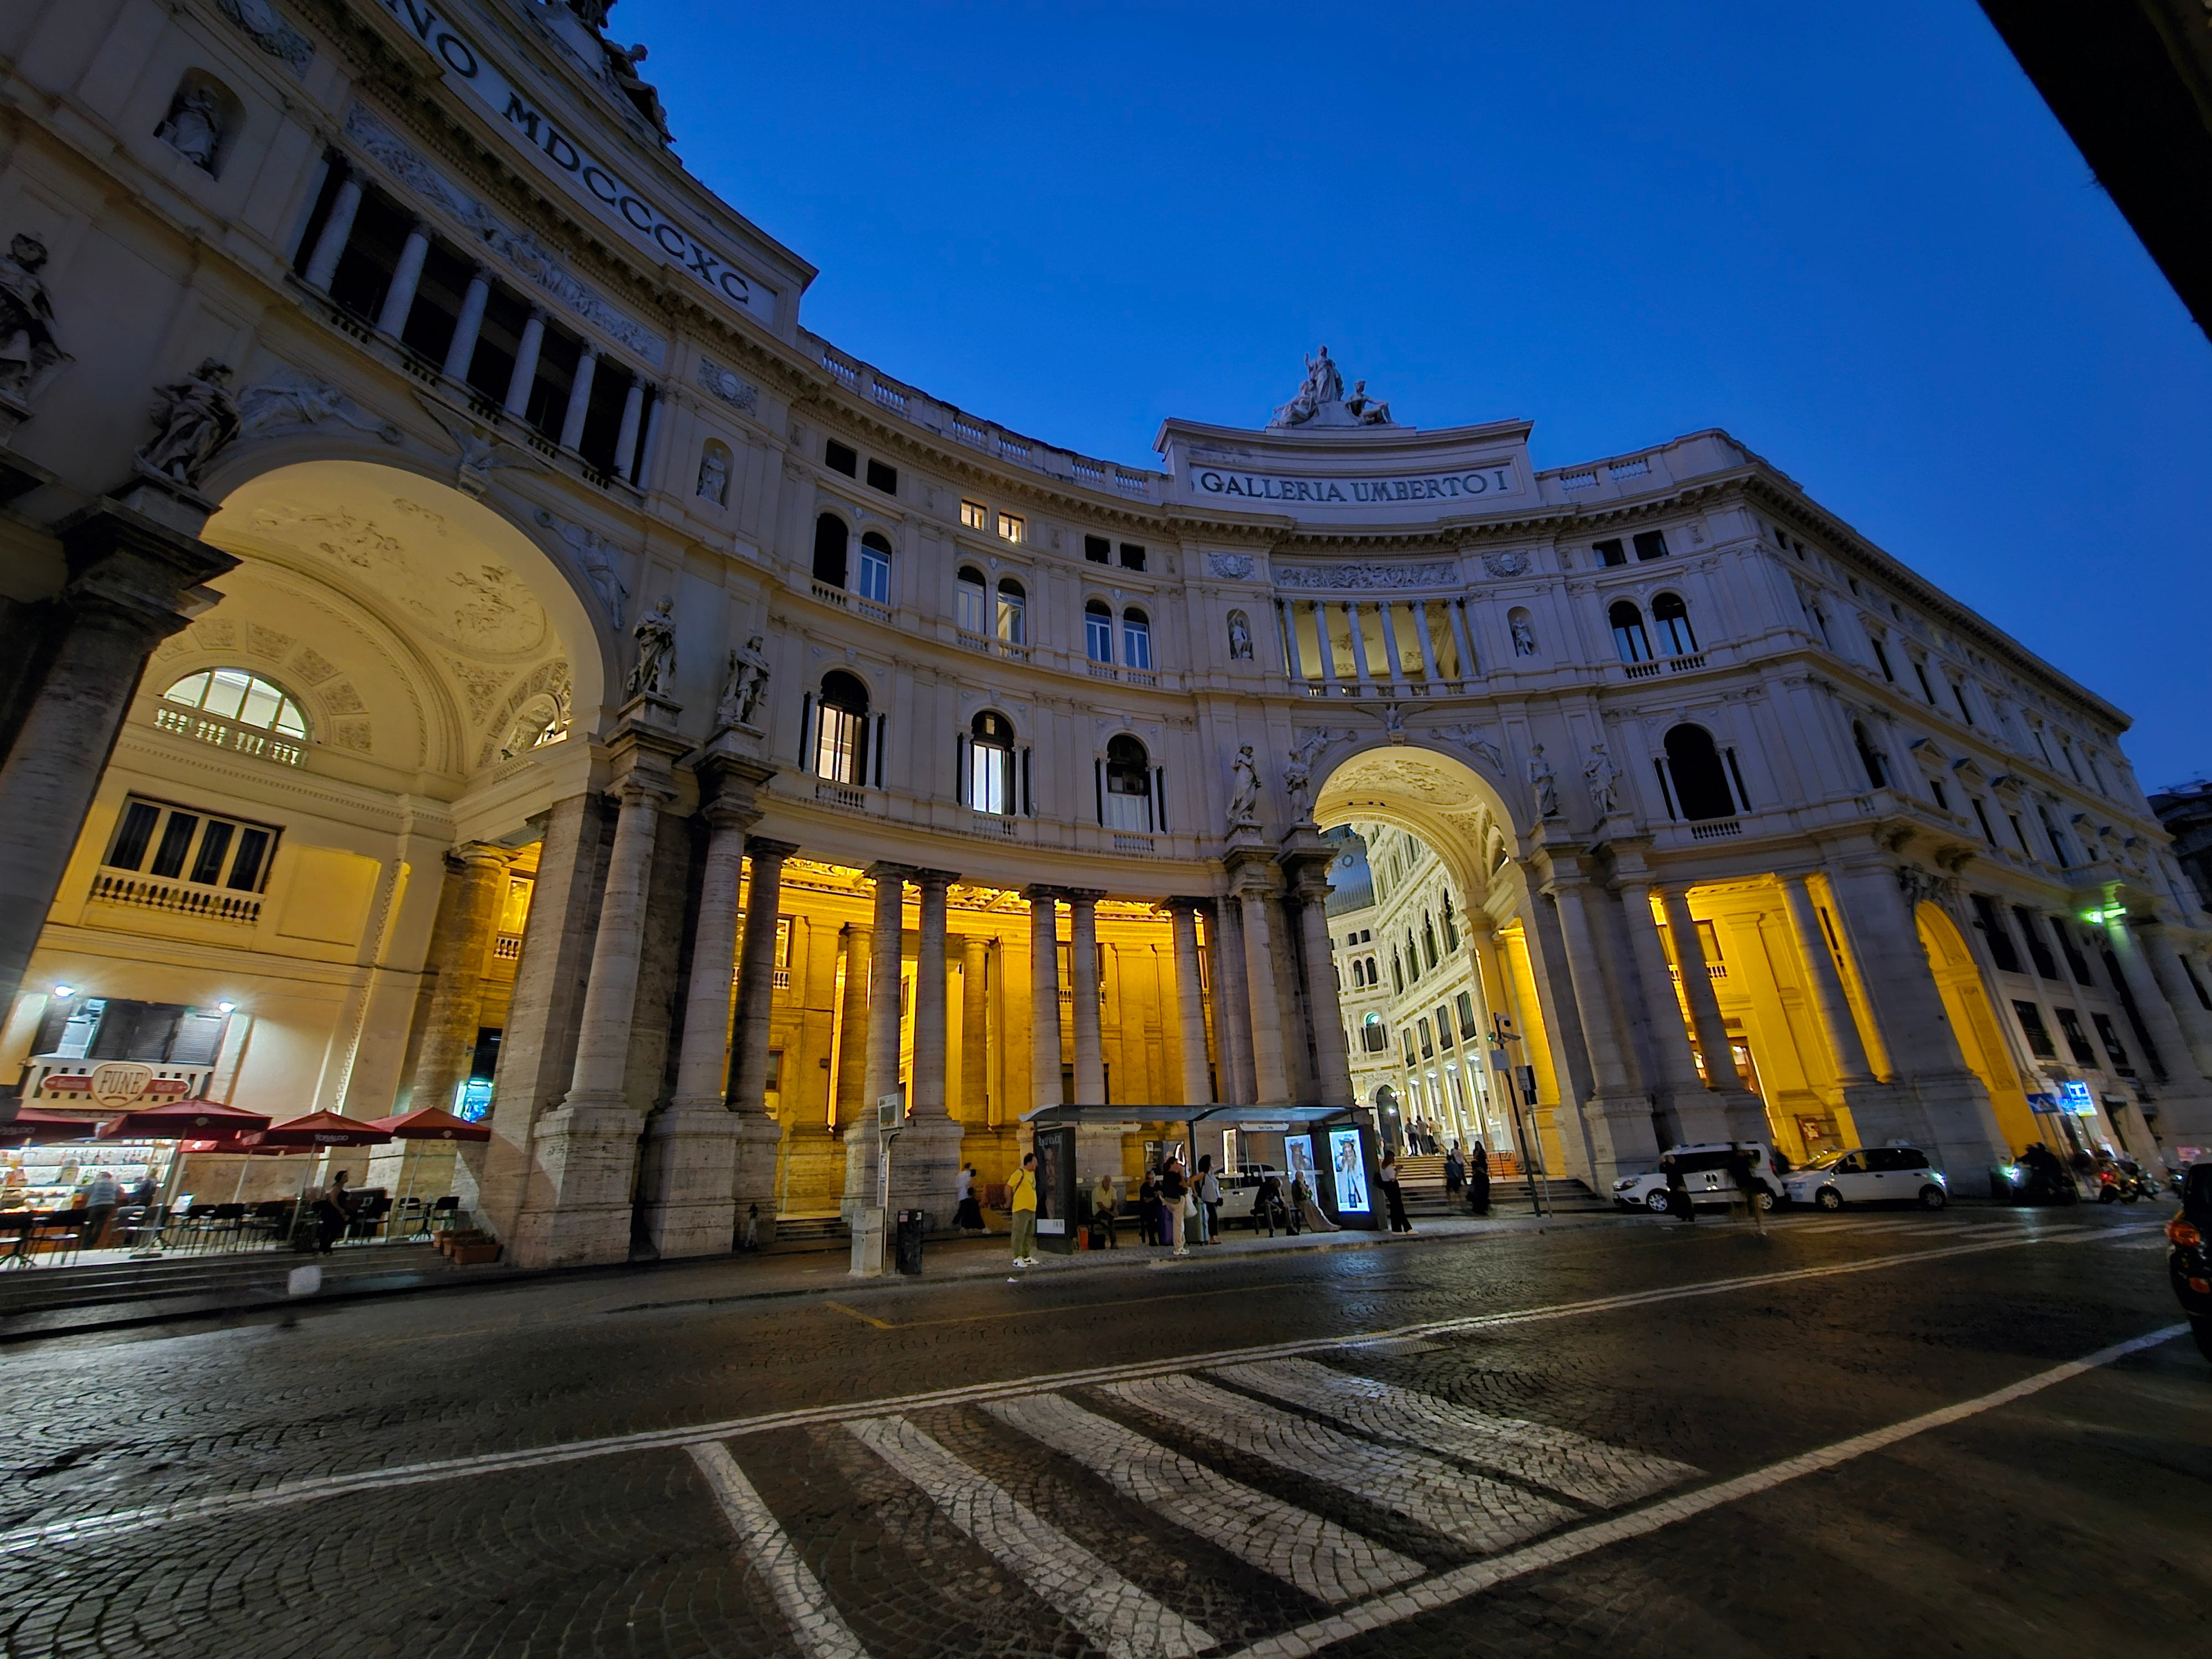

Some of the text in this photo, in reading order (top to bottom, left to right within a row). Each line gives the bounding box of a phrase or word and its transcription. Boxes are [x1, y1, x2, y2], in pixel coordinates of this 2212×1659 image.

[502, 92, 749, 305] MDCCCXC
[1201, 470, 1508, 503] GALLERIA UMBERTO I
